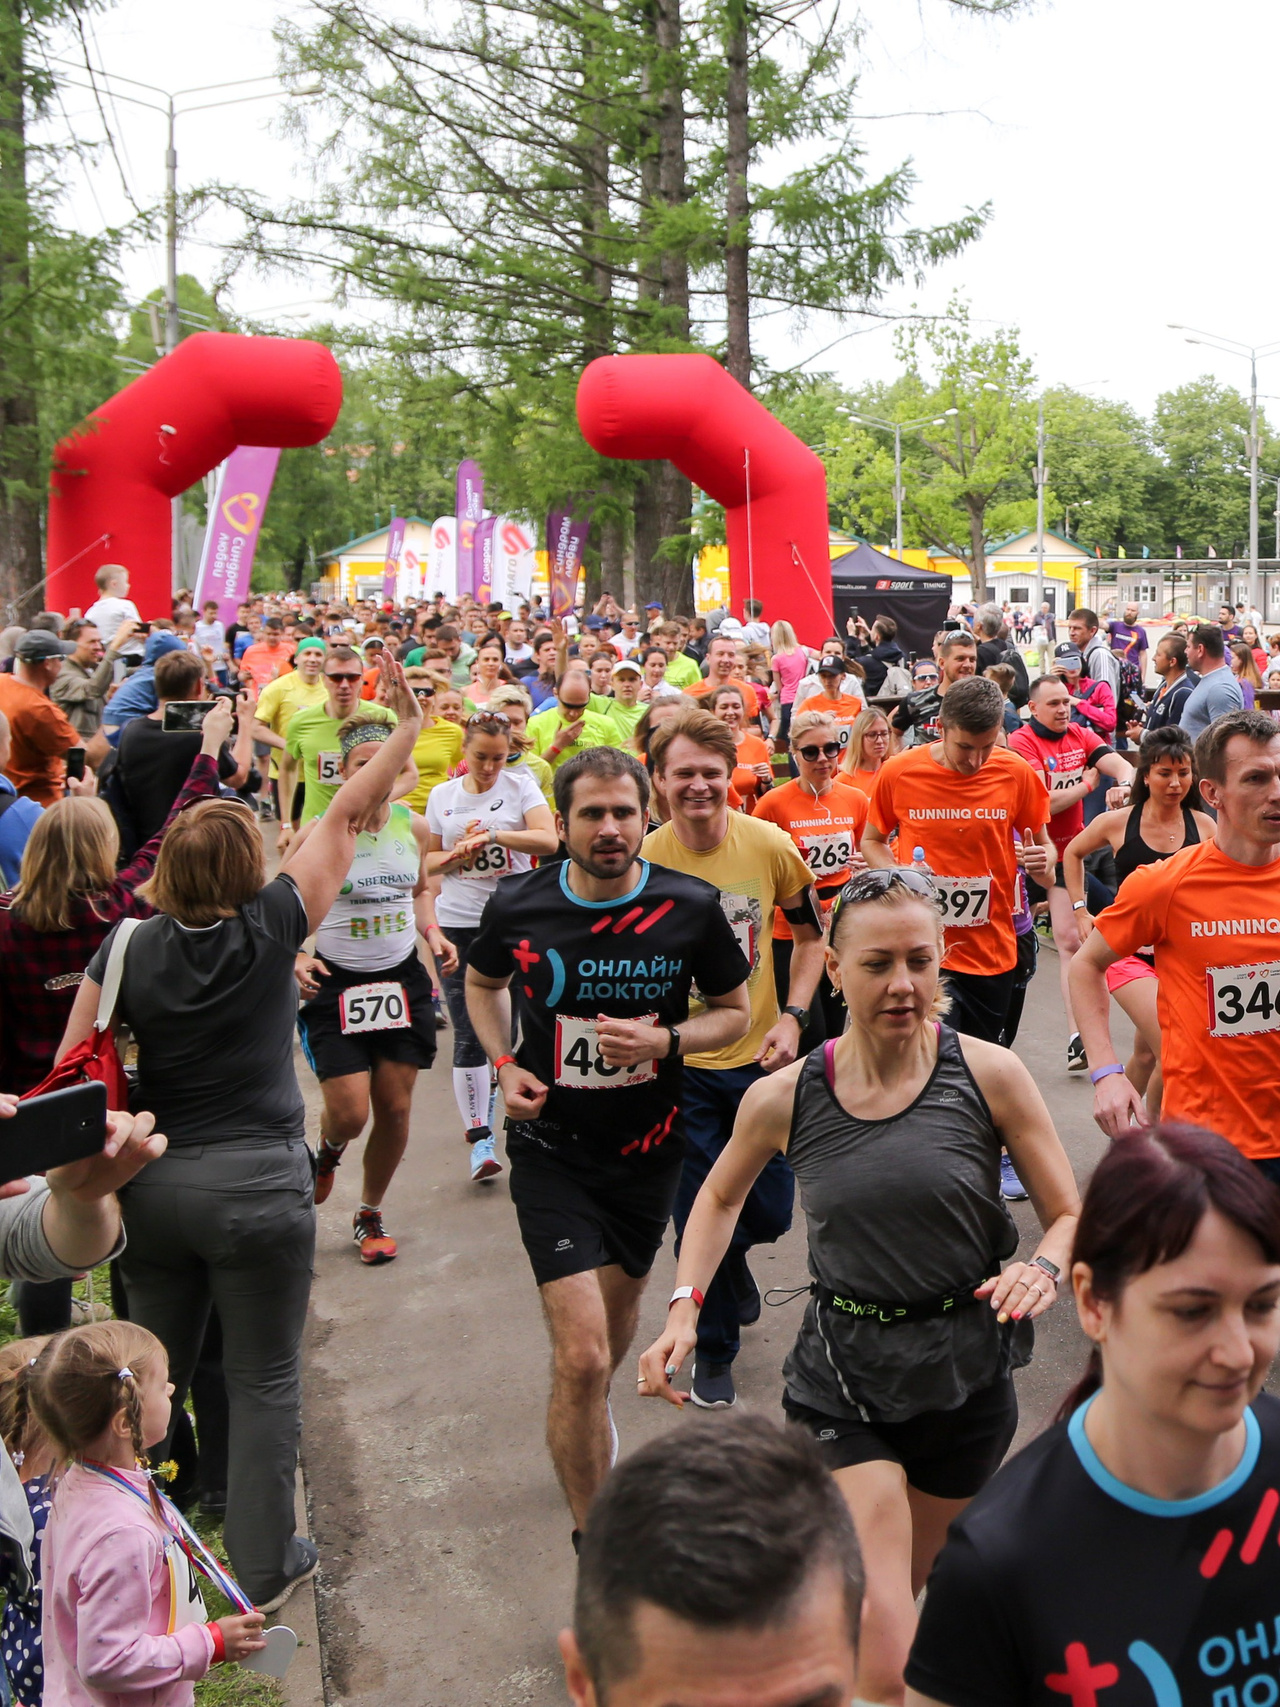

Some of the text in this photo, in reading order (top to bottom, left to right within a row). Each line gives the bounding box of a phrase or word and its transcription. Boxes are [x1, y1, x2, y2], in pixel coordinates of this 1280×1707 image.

[212, 532, 229, 578] любви
[554, 516, 571, 574] Синдром
[565, 536, 580, 578] любви
[223, 537, 246, 598] Синдром
[482, 538, 491, 583] Синдром
[834, 817, 854, 825] CLUB
[975, 808, 1007, 820] CLUB
[807, 842, 850, 868] 263
[357, 872, 416, 889] SBERBANK
[350, 897, 390, 905] TRIATHLON
[350, 911, 407, 939] RUS
[578, 955, 682, 978] ОНЛАЙН
[576, 981, 672, 1000] ДОКТОР
[348, 995, 402, 1025] 570
